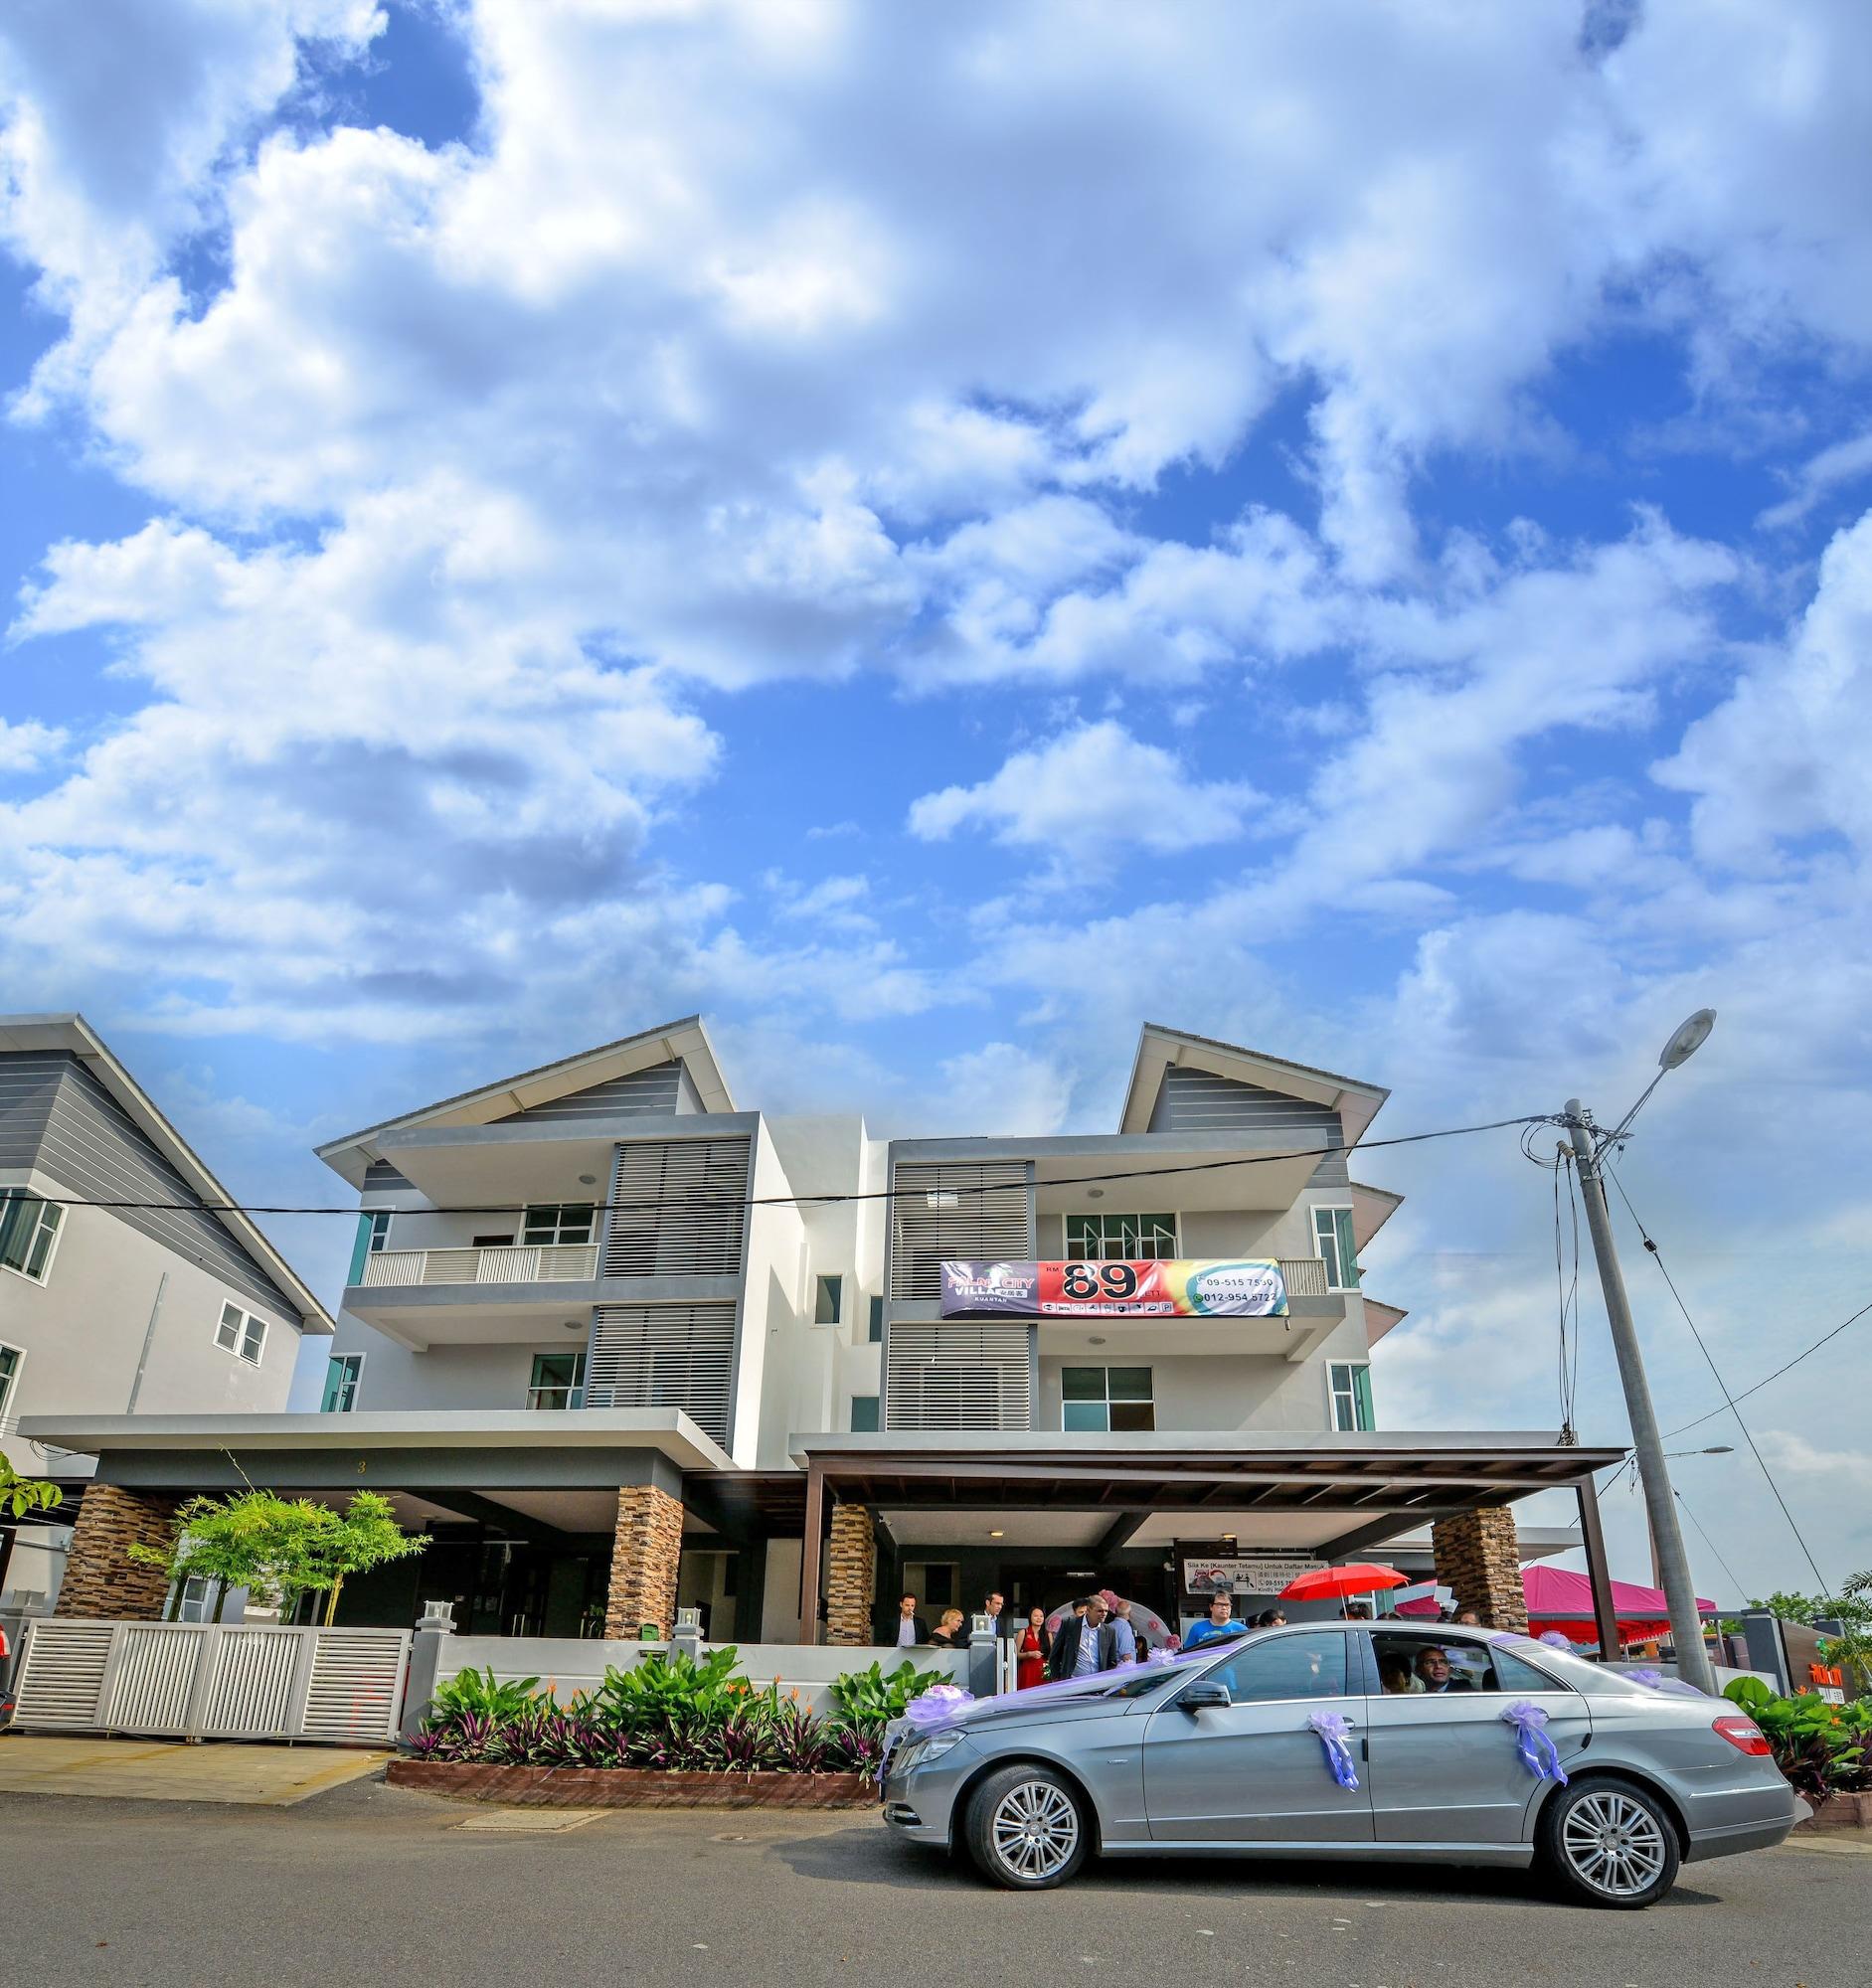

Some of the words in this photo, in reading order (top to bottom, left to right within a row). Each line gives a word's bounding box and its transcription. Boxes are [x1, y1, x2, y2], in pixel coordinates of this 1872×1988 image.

[1001, 1277, 1035, 1288] CITY
[1063, 1262, 1138, 1300] 89
[954, 1286, 995, 1296] VILLA
[1204, 1293, 1248, 1302] 012-954
[357, 1461, 367, 1475] 3
